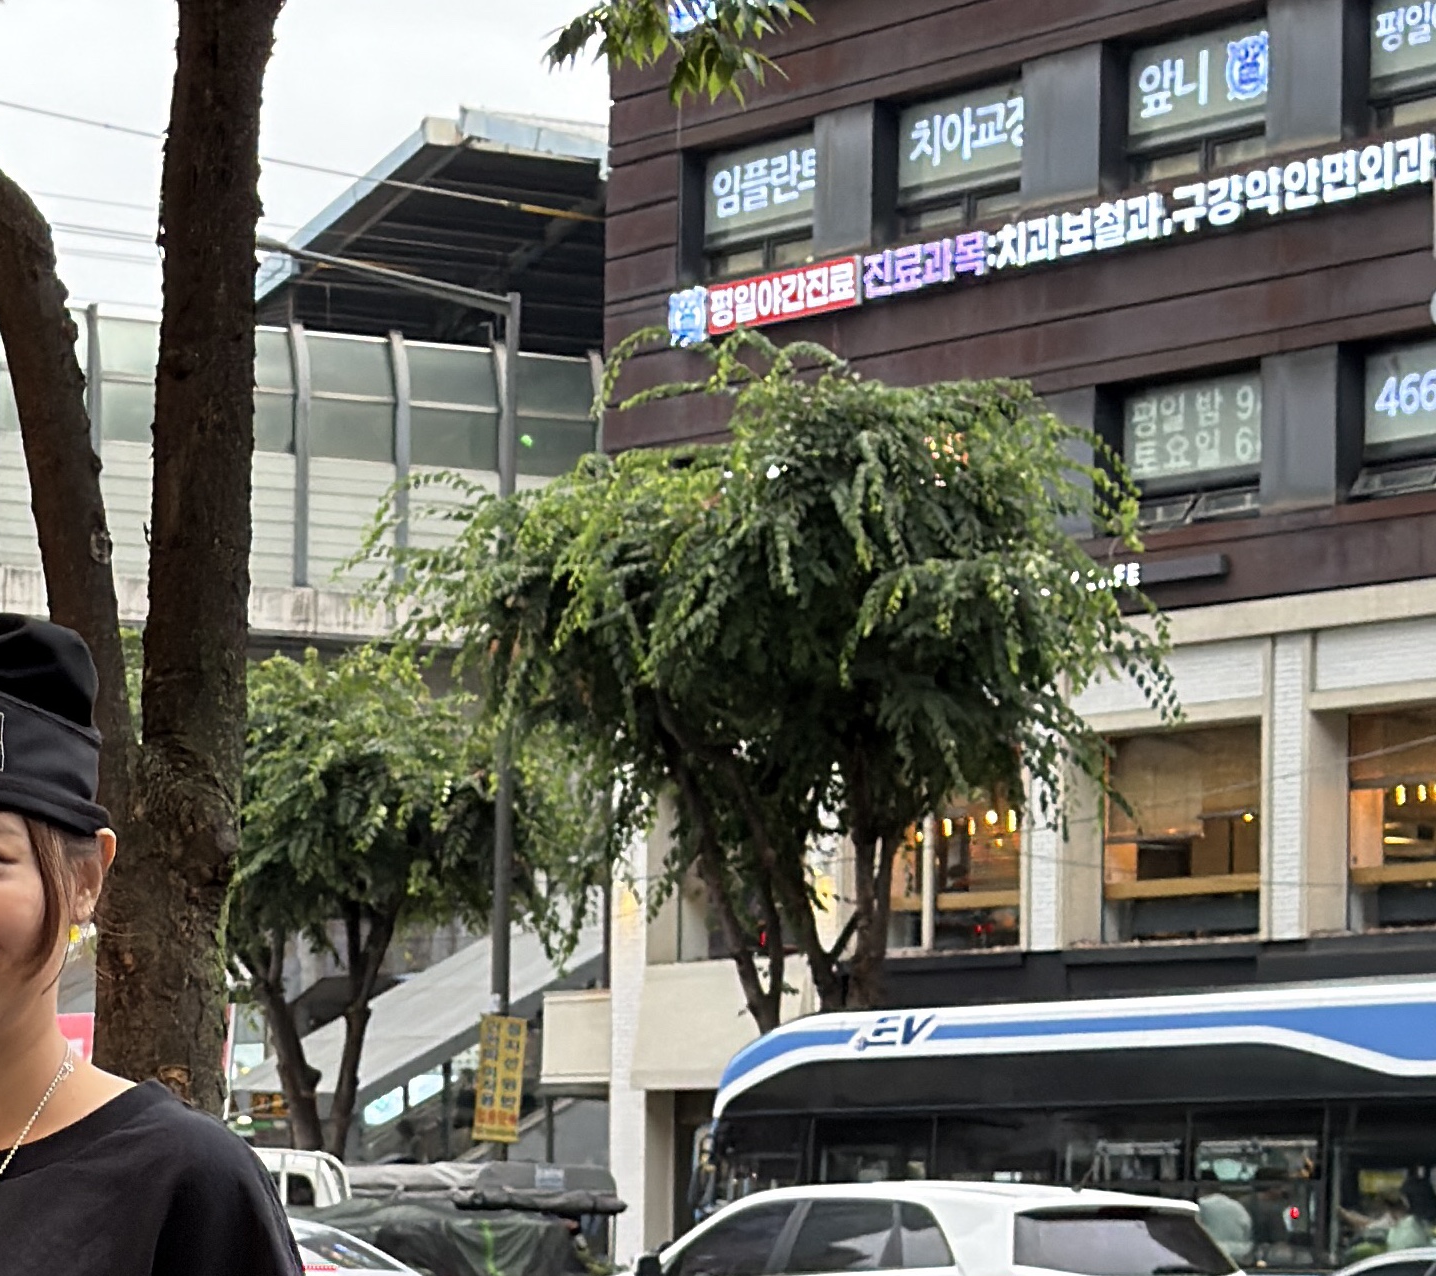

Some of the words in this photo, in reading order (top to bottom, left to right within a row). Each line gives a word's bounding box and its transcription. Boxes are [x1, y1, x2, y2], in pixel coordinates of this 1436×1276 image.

[1139, 49, 1209, 118] 앞니
[710, 262, 856, 327] 평일야간진료
[862, 1014, 936, 1048] EV
